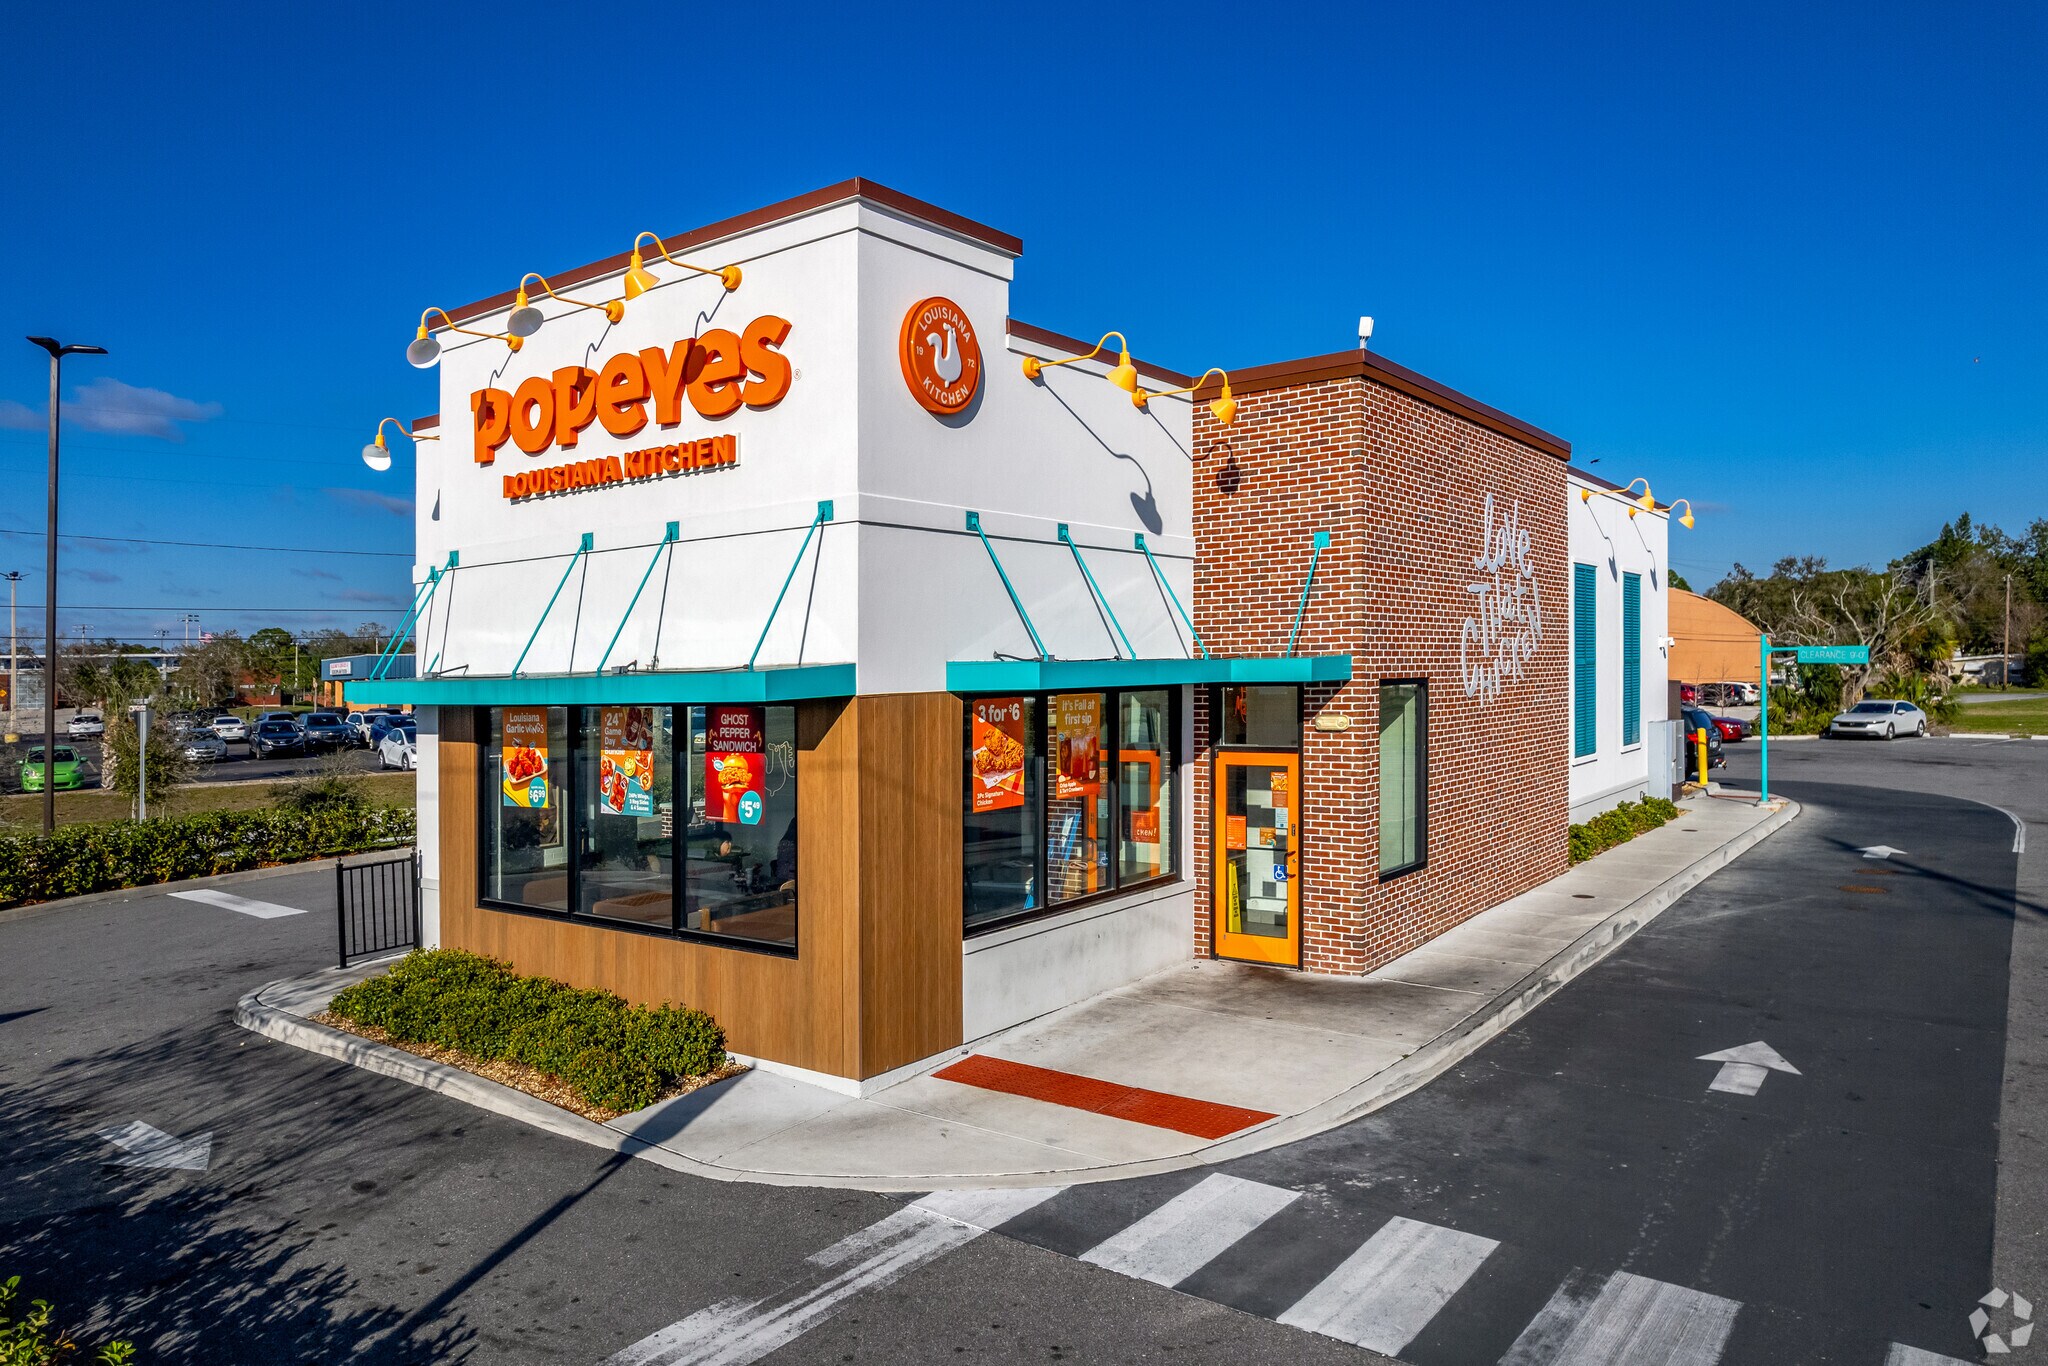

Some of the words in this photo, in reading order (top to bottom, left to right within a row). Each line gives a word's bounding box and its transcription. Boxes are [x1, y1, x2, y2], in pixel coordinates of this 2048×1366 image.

[919, 307, 970, 343] LOUISIANA
[916, 346, 924, 355] 19
[967, 358, 975, 368] 72
[923, 376, 969, 405] KITCHEN
[503, 455, 624, 499] LOUISIANA
[624, 433, 737, 481] KITCHEN
[1800, 650, 1846, 659] CLEARANCE
[510, 713, 540, 722] Louisiana
[720, 713, 749, 725] GHOST
[978, 704, 987, 723] 3
[988, 704, 1008, 722] for
[1008, 703, 1020, 721] $6
[1065, 713, 1081, 725] first
[1082, 712, 1092, 726] sip
[506, 723, 525, 733] Garlic
[604, 727, 622, 735] Game
[719, 727, 751, 739] PEPPER
[604, 736, 616, 747] Day
[713, 740, 757, 752] SANDWICH
